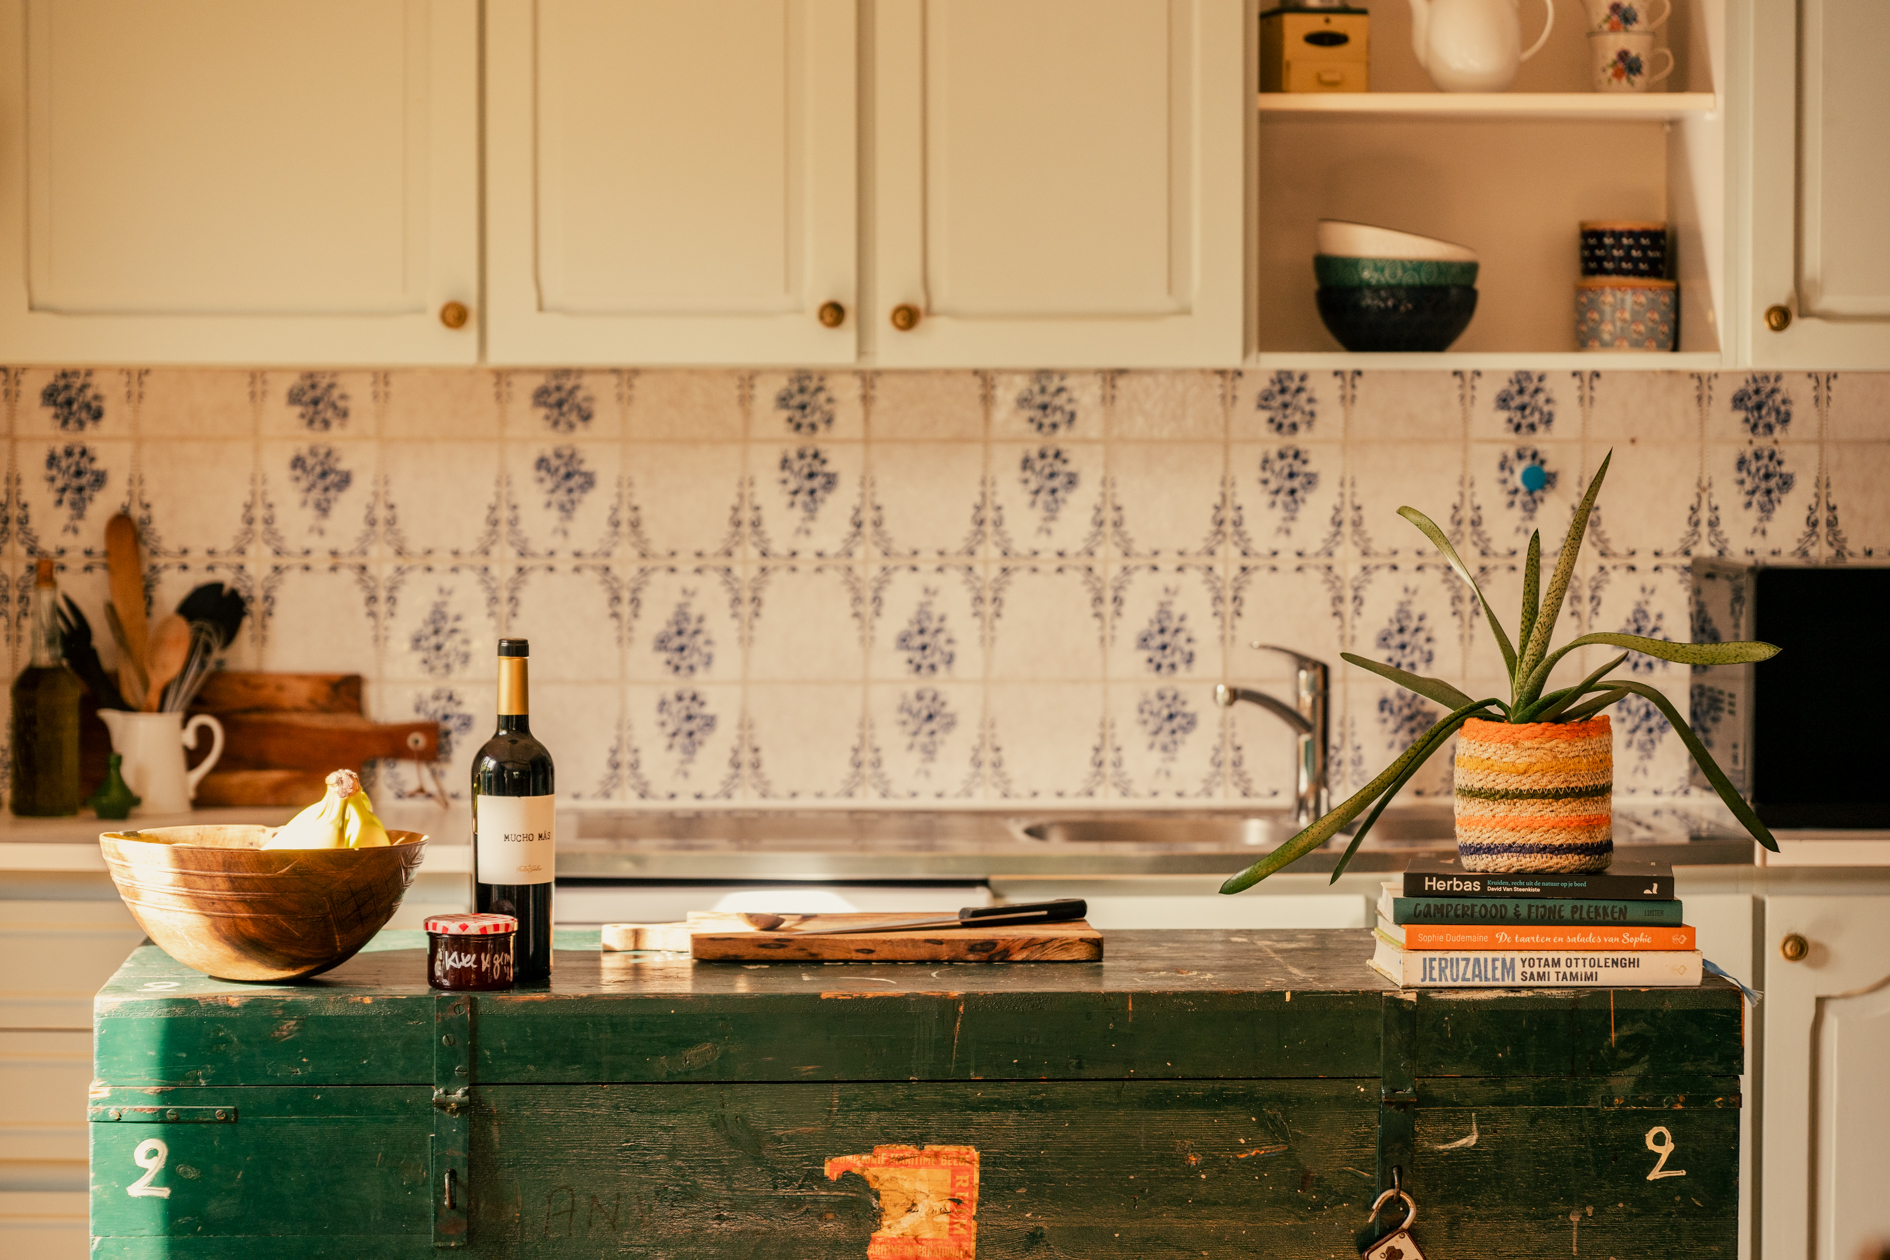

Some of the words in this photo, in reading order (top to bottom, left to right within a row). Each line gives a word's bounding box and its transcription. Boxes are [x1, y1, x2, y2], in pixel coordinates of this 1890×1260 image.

[504, 833, 534, 843] MUCHO
[537, 830, 551, 842] MÁS
[1424, 876, 1481, 892] Herbas
[1487, 879, 1510, 887] Kruiden,
[1413, 902, 1508, 919] CAMPERFOOD
[1513, 903, 1522, 919] &
[1527, 903, 1565, 920] FIJNE
[1570, 904, 1628, 921] PLEKKEN
[1644, 909, 1665, 917] LUSTER
[1417, 933, 1444, 943] Sophie
[1446, 933, 1489, 942] Dudemaine
[1495, 931, 1512, 944] De
[1514, 934, 1551, 943] taarten
[1566, 932, 1602, 943] salades
[1621, 932, 1652, 947] Sophie
[1421, 957, 1516, 982] JERUZALEM
[1520, 957, 1561, 968] YOTAM
[1565, 957, 1640, 968] OTTOLENGHI
[1520, 971, 1550, 982] SAMI
[1555, 971, 1598, 982] TAMIMI
[1644, 1126, 1687, 1181] 2
[125, 1138, 172, 1199] 2
